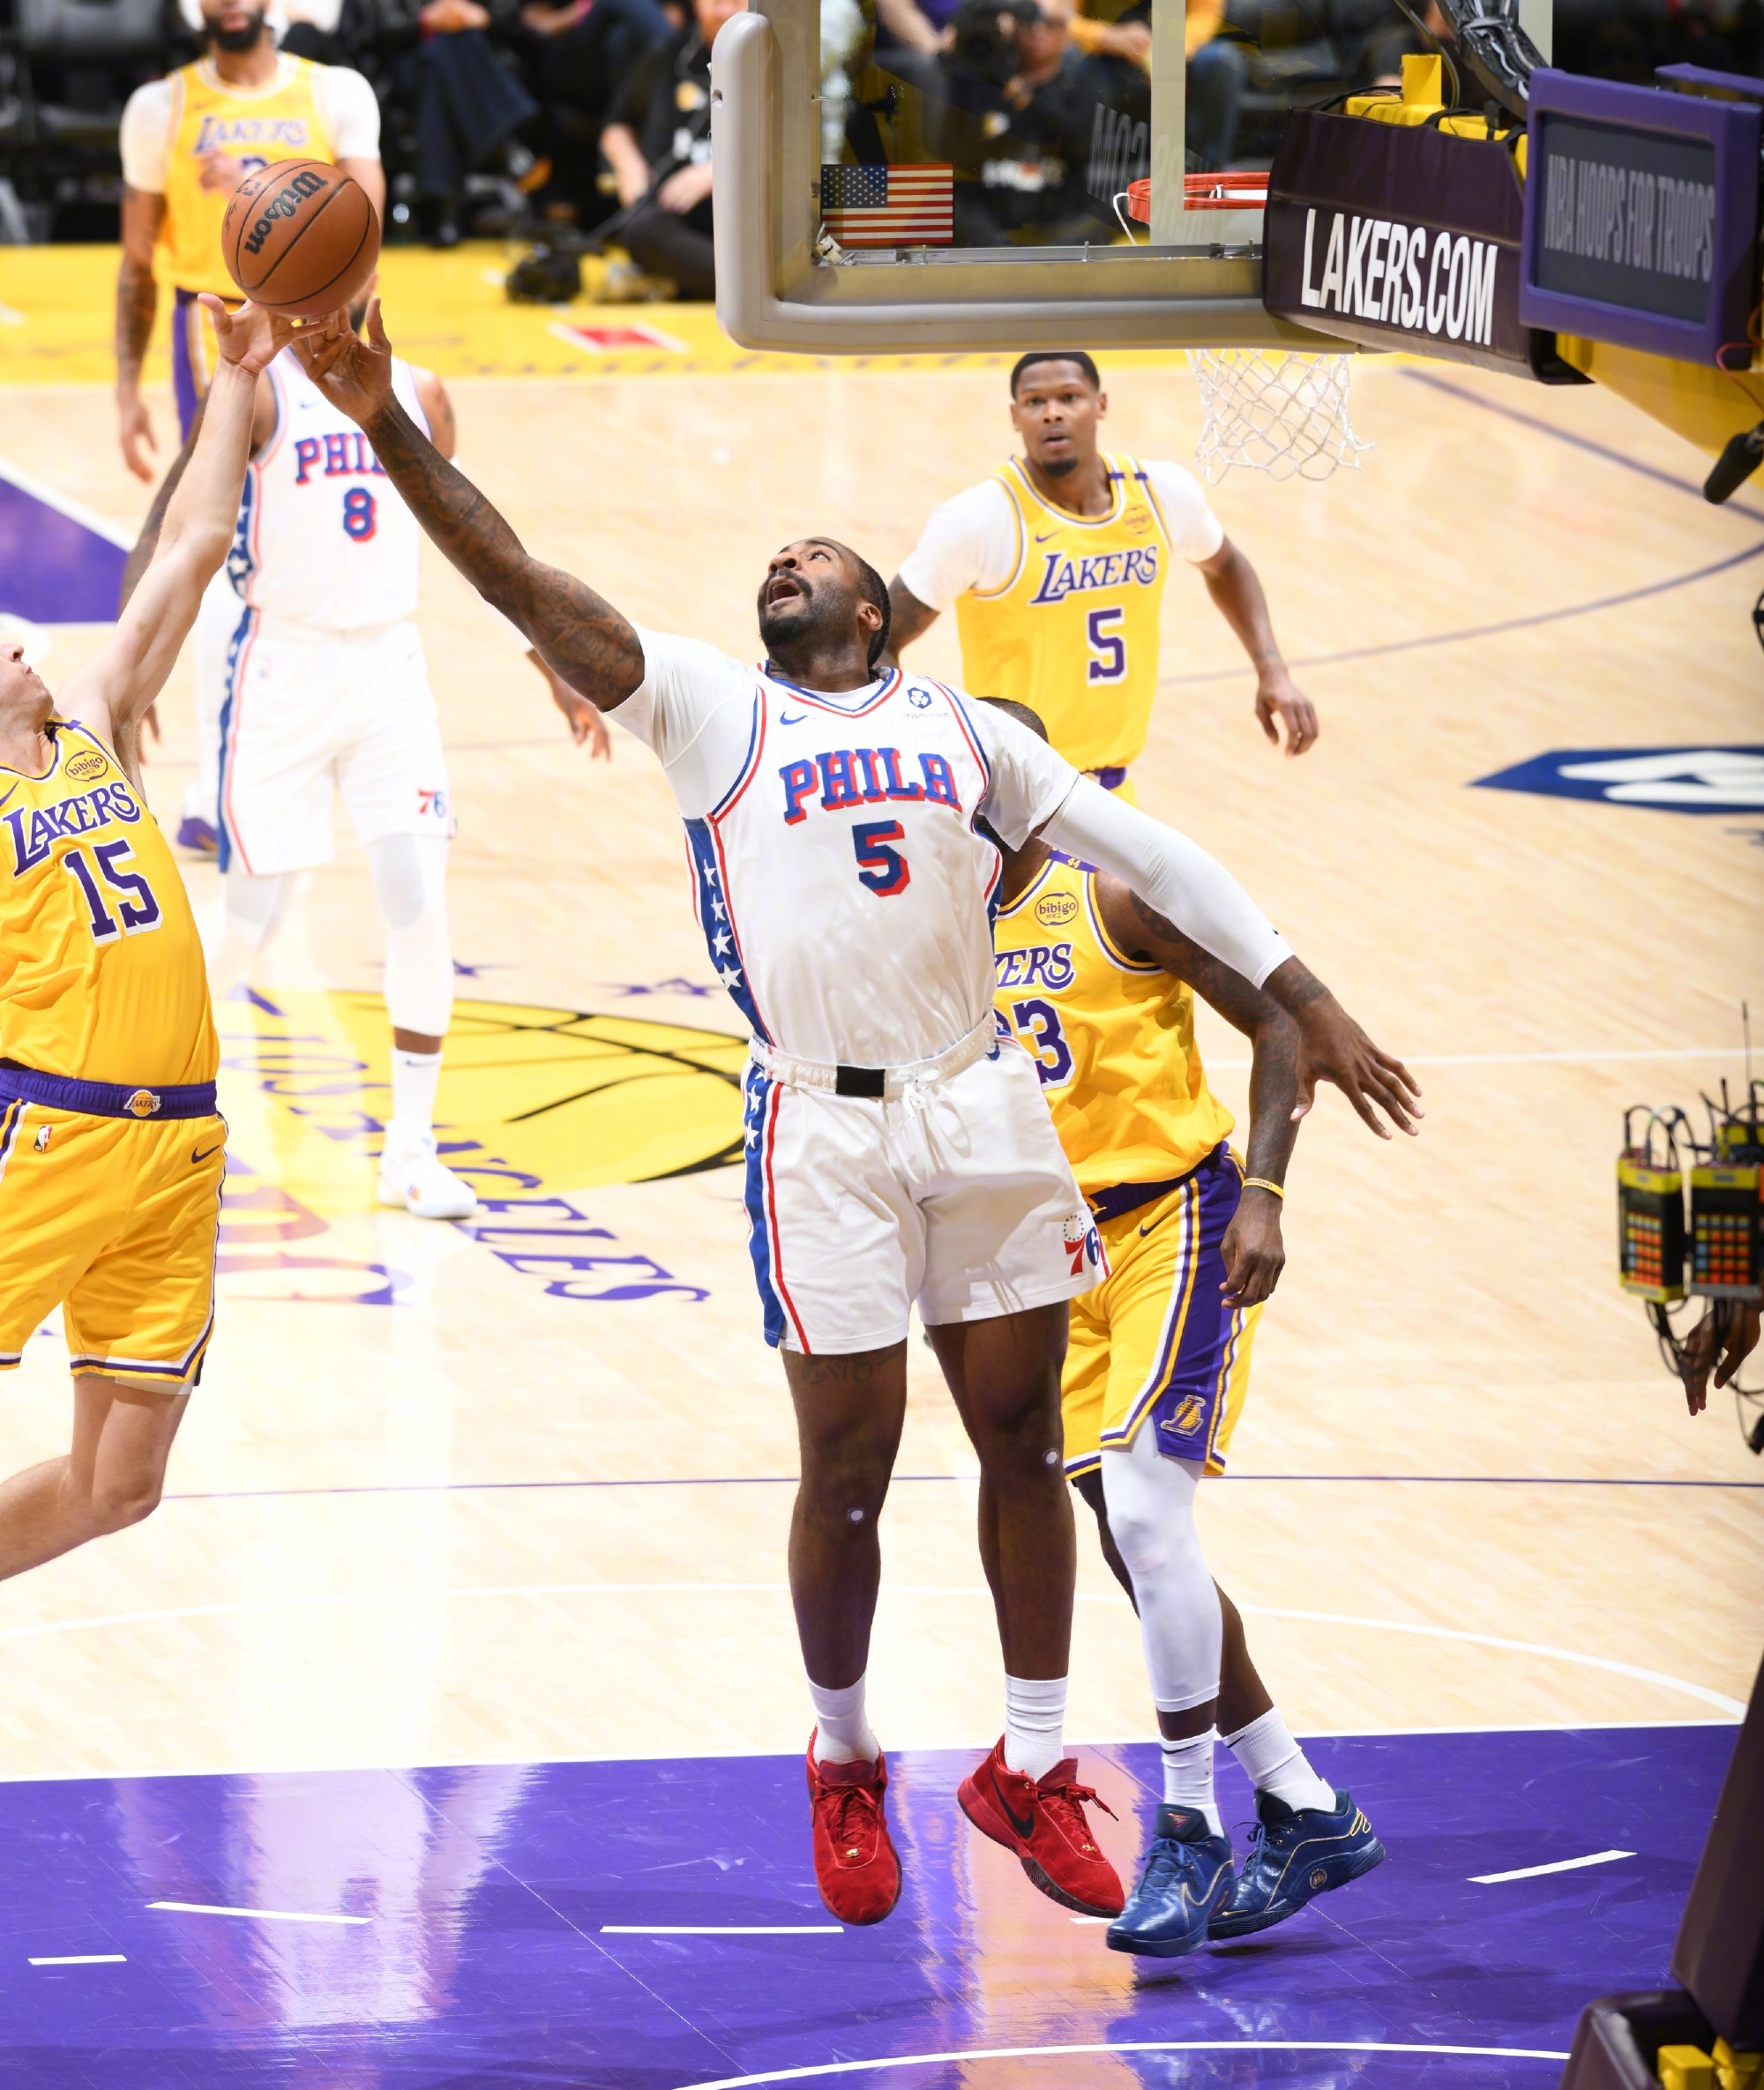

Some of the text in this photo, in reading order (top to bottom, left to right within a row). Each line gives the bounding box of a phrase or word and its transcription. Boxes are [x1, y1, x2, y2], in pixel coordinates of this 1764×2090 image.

[193, 116, 306, 153] LAKERS
[244, 171, 329, 255] Wilson
[1544, 154, 1715, 282] NBA HOOPS FOR TROOPS
[1301, 208, 1499, 346] LAKERS.COM
[295, 431, 389, 485] PHI
[343, 487, 377, 542] 8
[1029, 546, 1158, 605] LAKERS
[1087, 607, 1127, 687] 5
[68, 757, 103, 775] bibigo
[779, 747, 963, 826] PHILA
[3, 782, 141, 879] LAKERS
[418, 789, 446, 818] 76
[852, 820, 910, 897] 5
[64, 836, 164, 946] 15
[1039, 902, 1076, 915] bibigo
[994, 942, 1076, 992] ERS
[1064, 1226, 1100, 1277] 76
